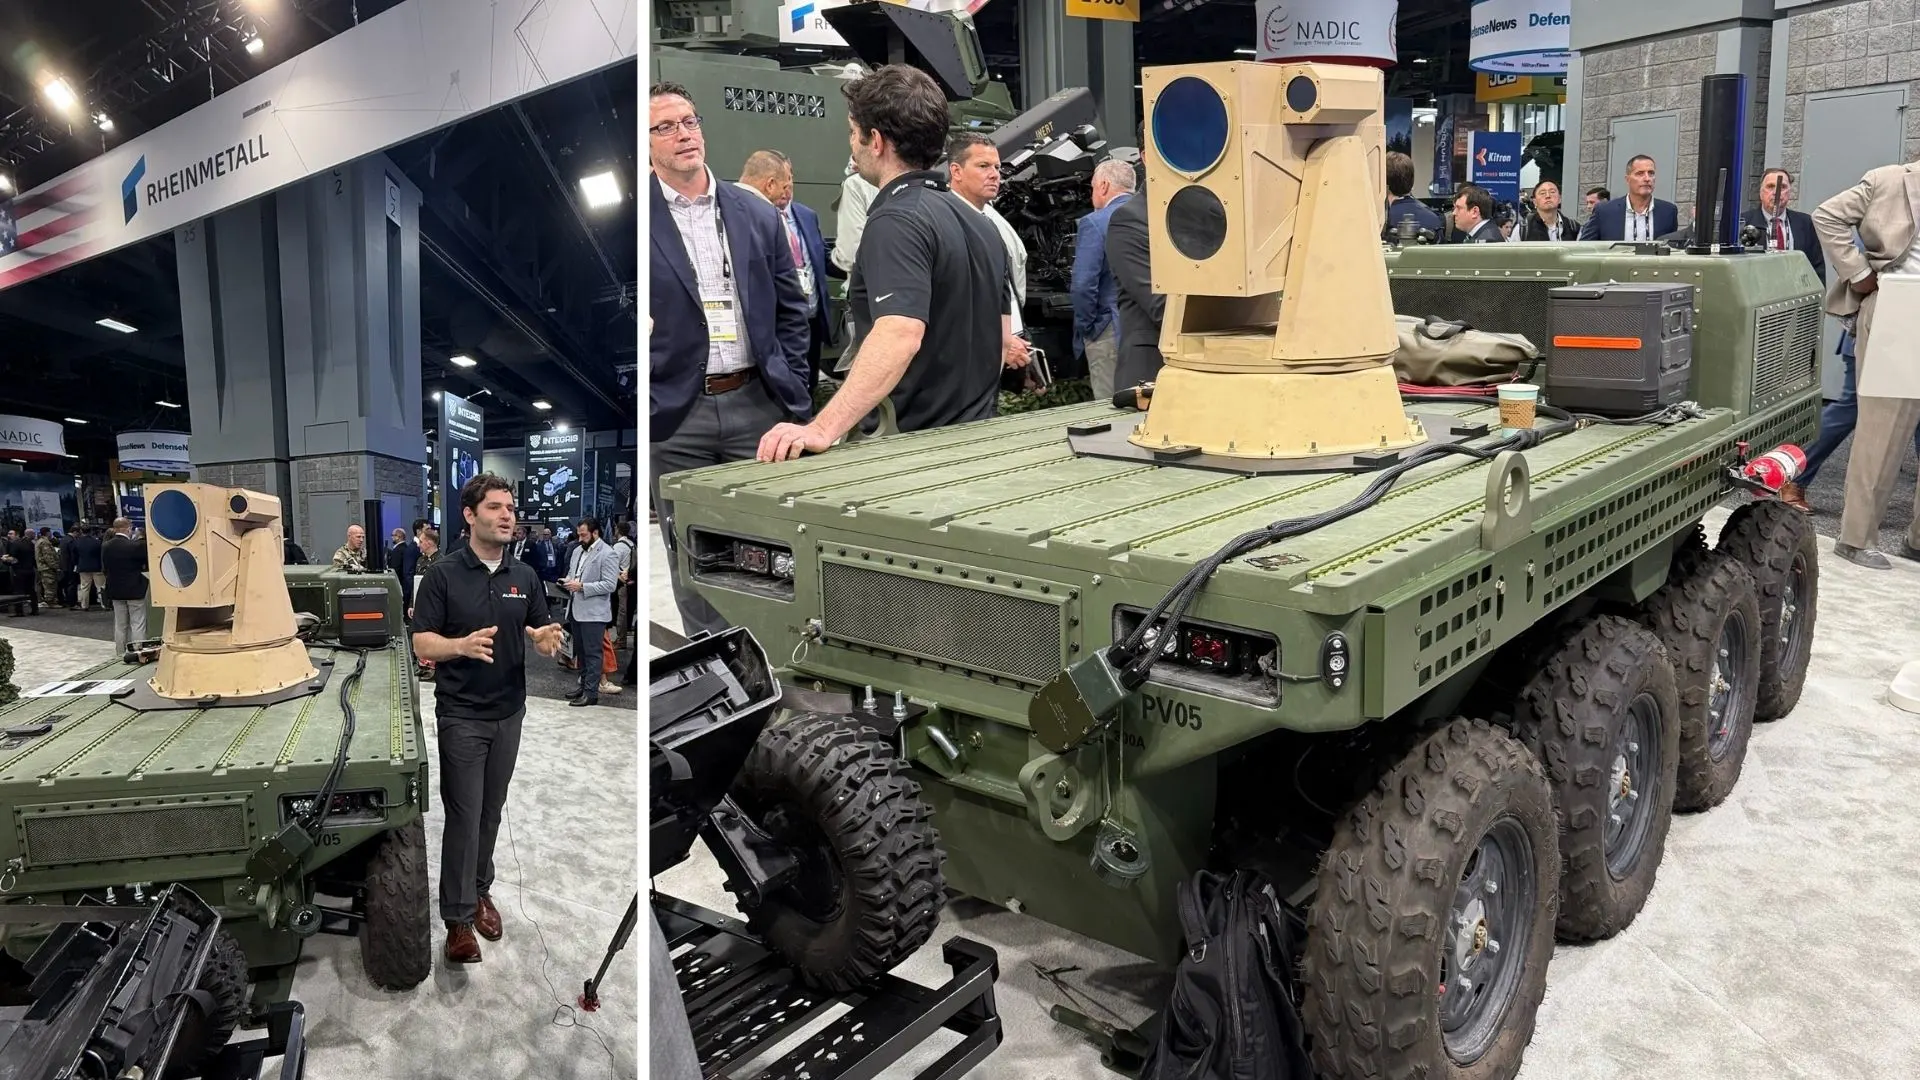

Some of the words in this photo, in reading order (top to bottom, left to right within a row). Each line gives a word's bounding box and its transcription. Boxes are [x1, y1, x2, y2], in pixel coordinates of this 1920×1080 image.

[1297, 21, 1360, 40] NADIC
[1488, 152, 1511, 162] Kitron
[147, 134, 269, 205] RHEINMETALL
[335, 179, 343, 196] 2
[389, 185, 396, 201] C
[390, 203, 396, 218] 2
[543, 434, 578, 445] INTEGRIS
[1141, 692, 1203, 731] PV05
